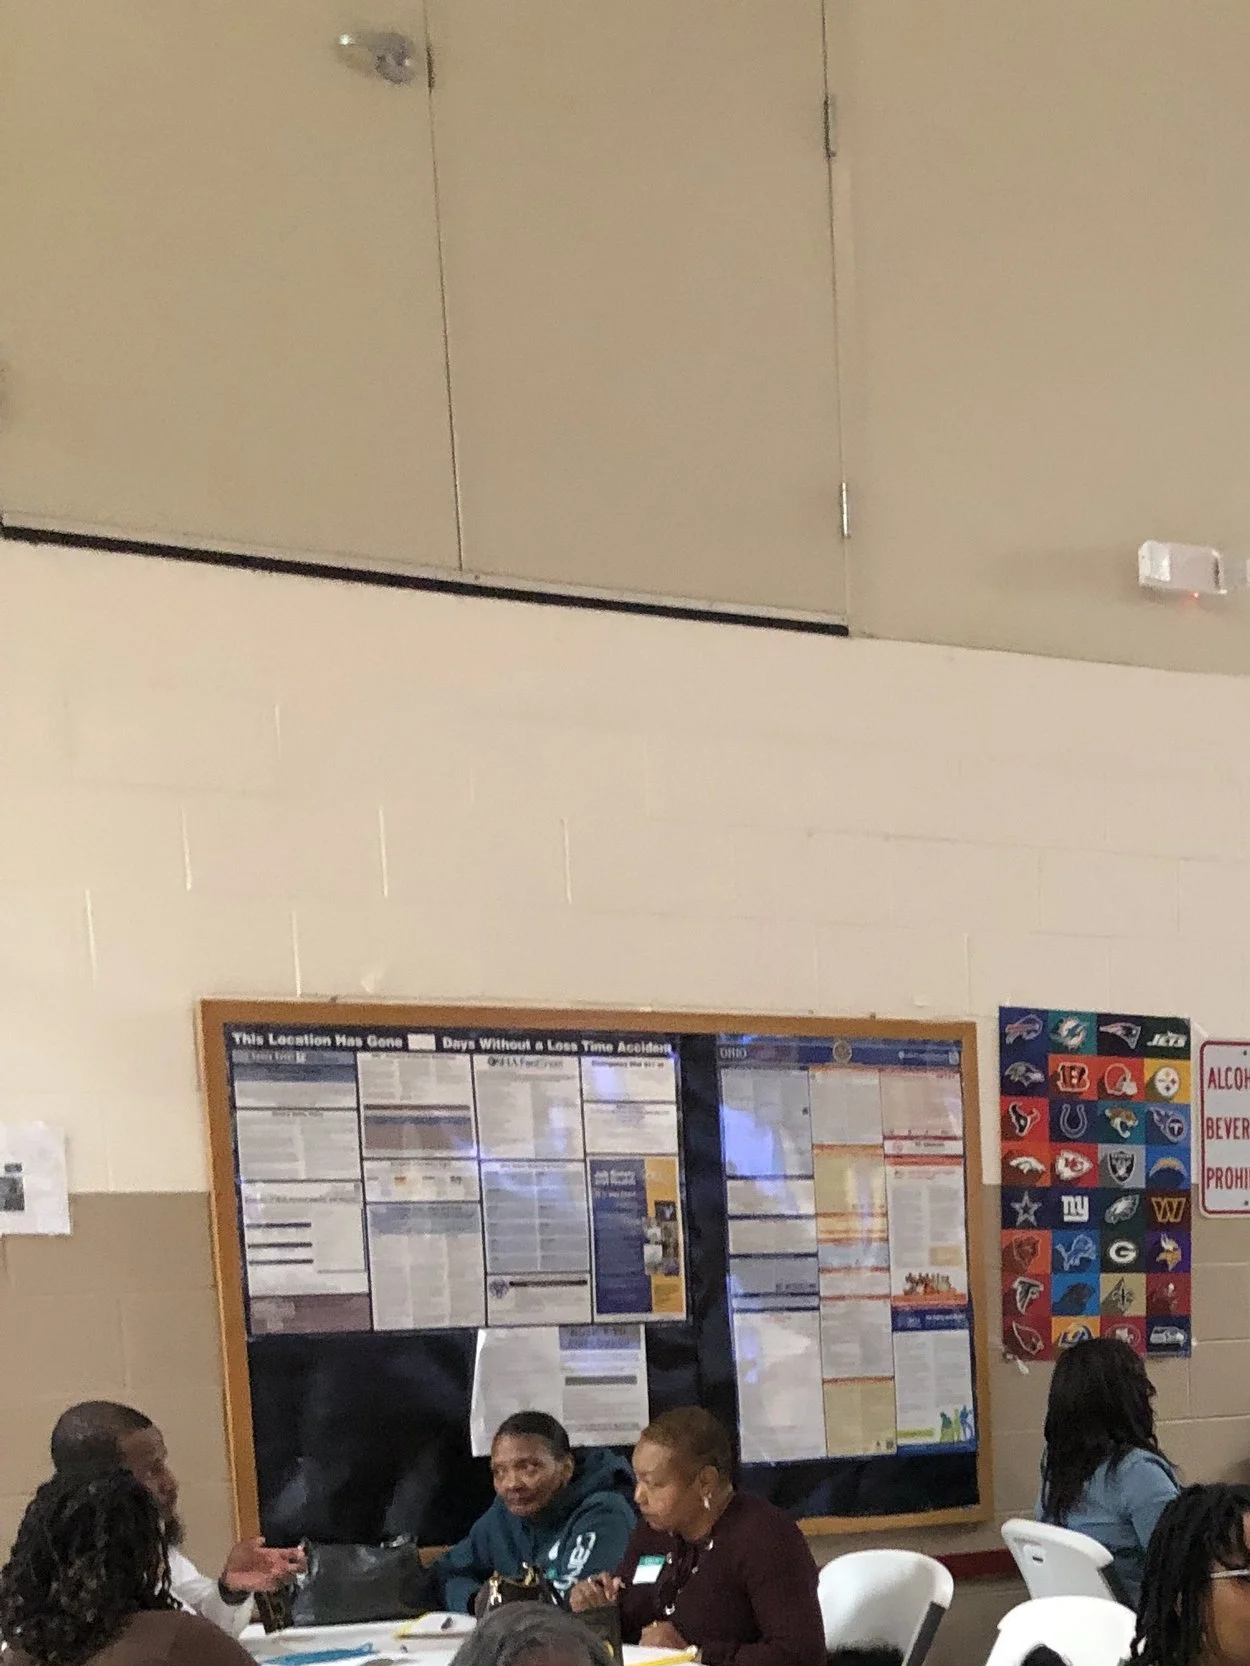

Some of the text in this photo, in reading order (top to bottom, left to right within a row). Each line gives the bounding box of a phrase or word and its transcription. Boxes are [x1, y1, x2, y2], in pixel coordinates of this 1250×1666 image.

[231, 1031, 264, 1046] This
[268, 1033, 332, 1047] Location
[335, 1034, 363, 1047] Has
[367, 1035, 403, 1048] Gone
[442, 1036, 476, 1052] Days
[479, 1037, 531, 1051] Without
[535, 1040, 544, 1051] a
[582, 1040, 613, 1053] Time
[617, 1041, 672, 1054] Accident
[1109, 1240, 1137, 1264] G
